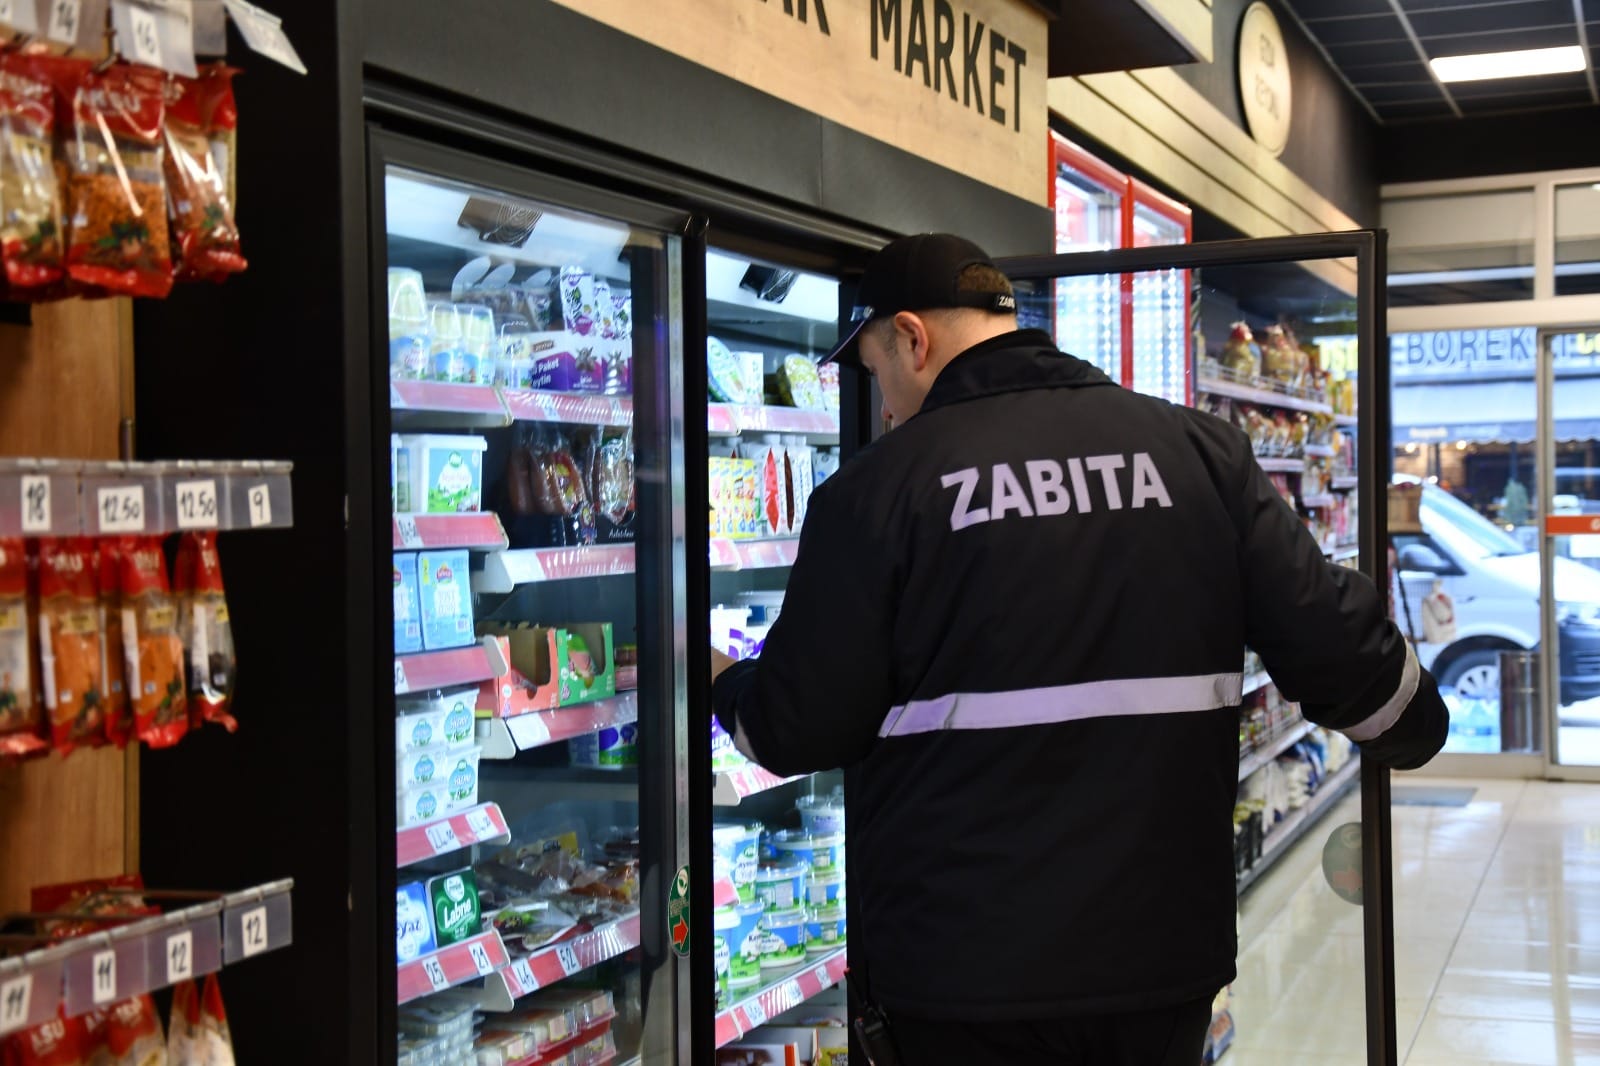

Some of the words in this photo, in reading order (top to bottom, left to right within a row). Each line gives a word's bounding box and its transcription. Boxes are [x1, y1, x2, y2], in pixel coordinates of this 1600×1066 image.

[870, 0, 1027, 132] MARKET
[25, 483, 45, 522] 18
[252, 491, 266, 520] 9
[940, 451, 1174, 532] ZABITA
[245, 914, 263, 945] 12
[443, 897, 472, 929] Labne
[97, 956, 113, 991] 11
[170, 942, 190, 975] 12
[6, 982, 26, 1021] 11
